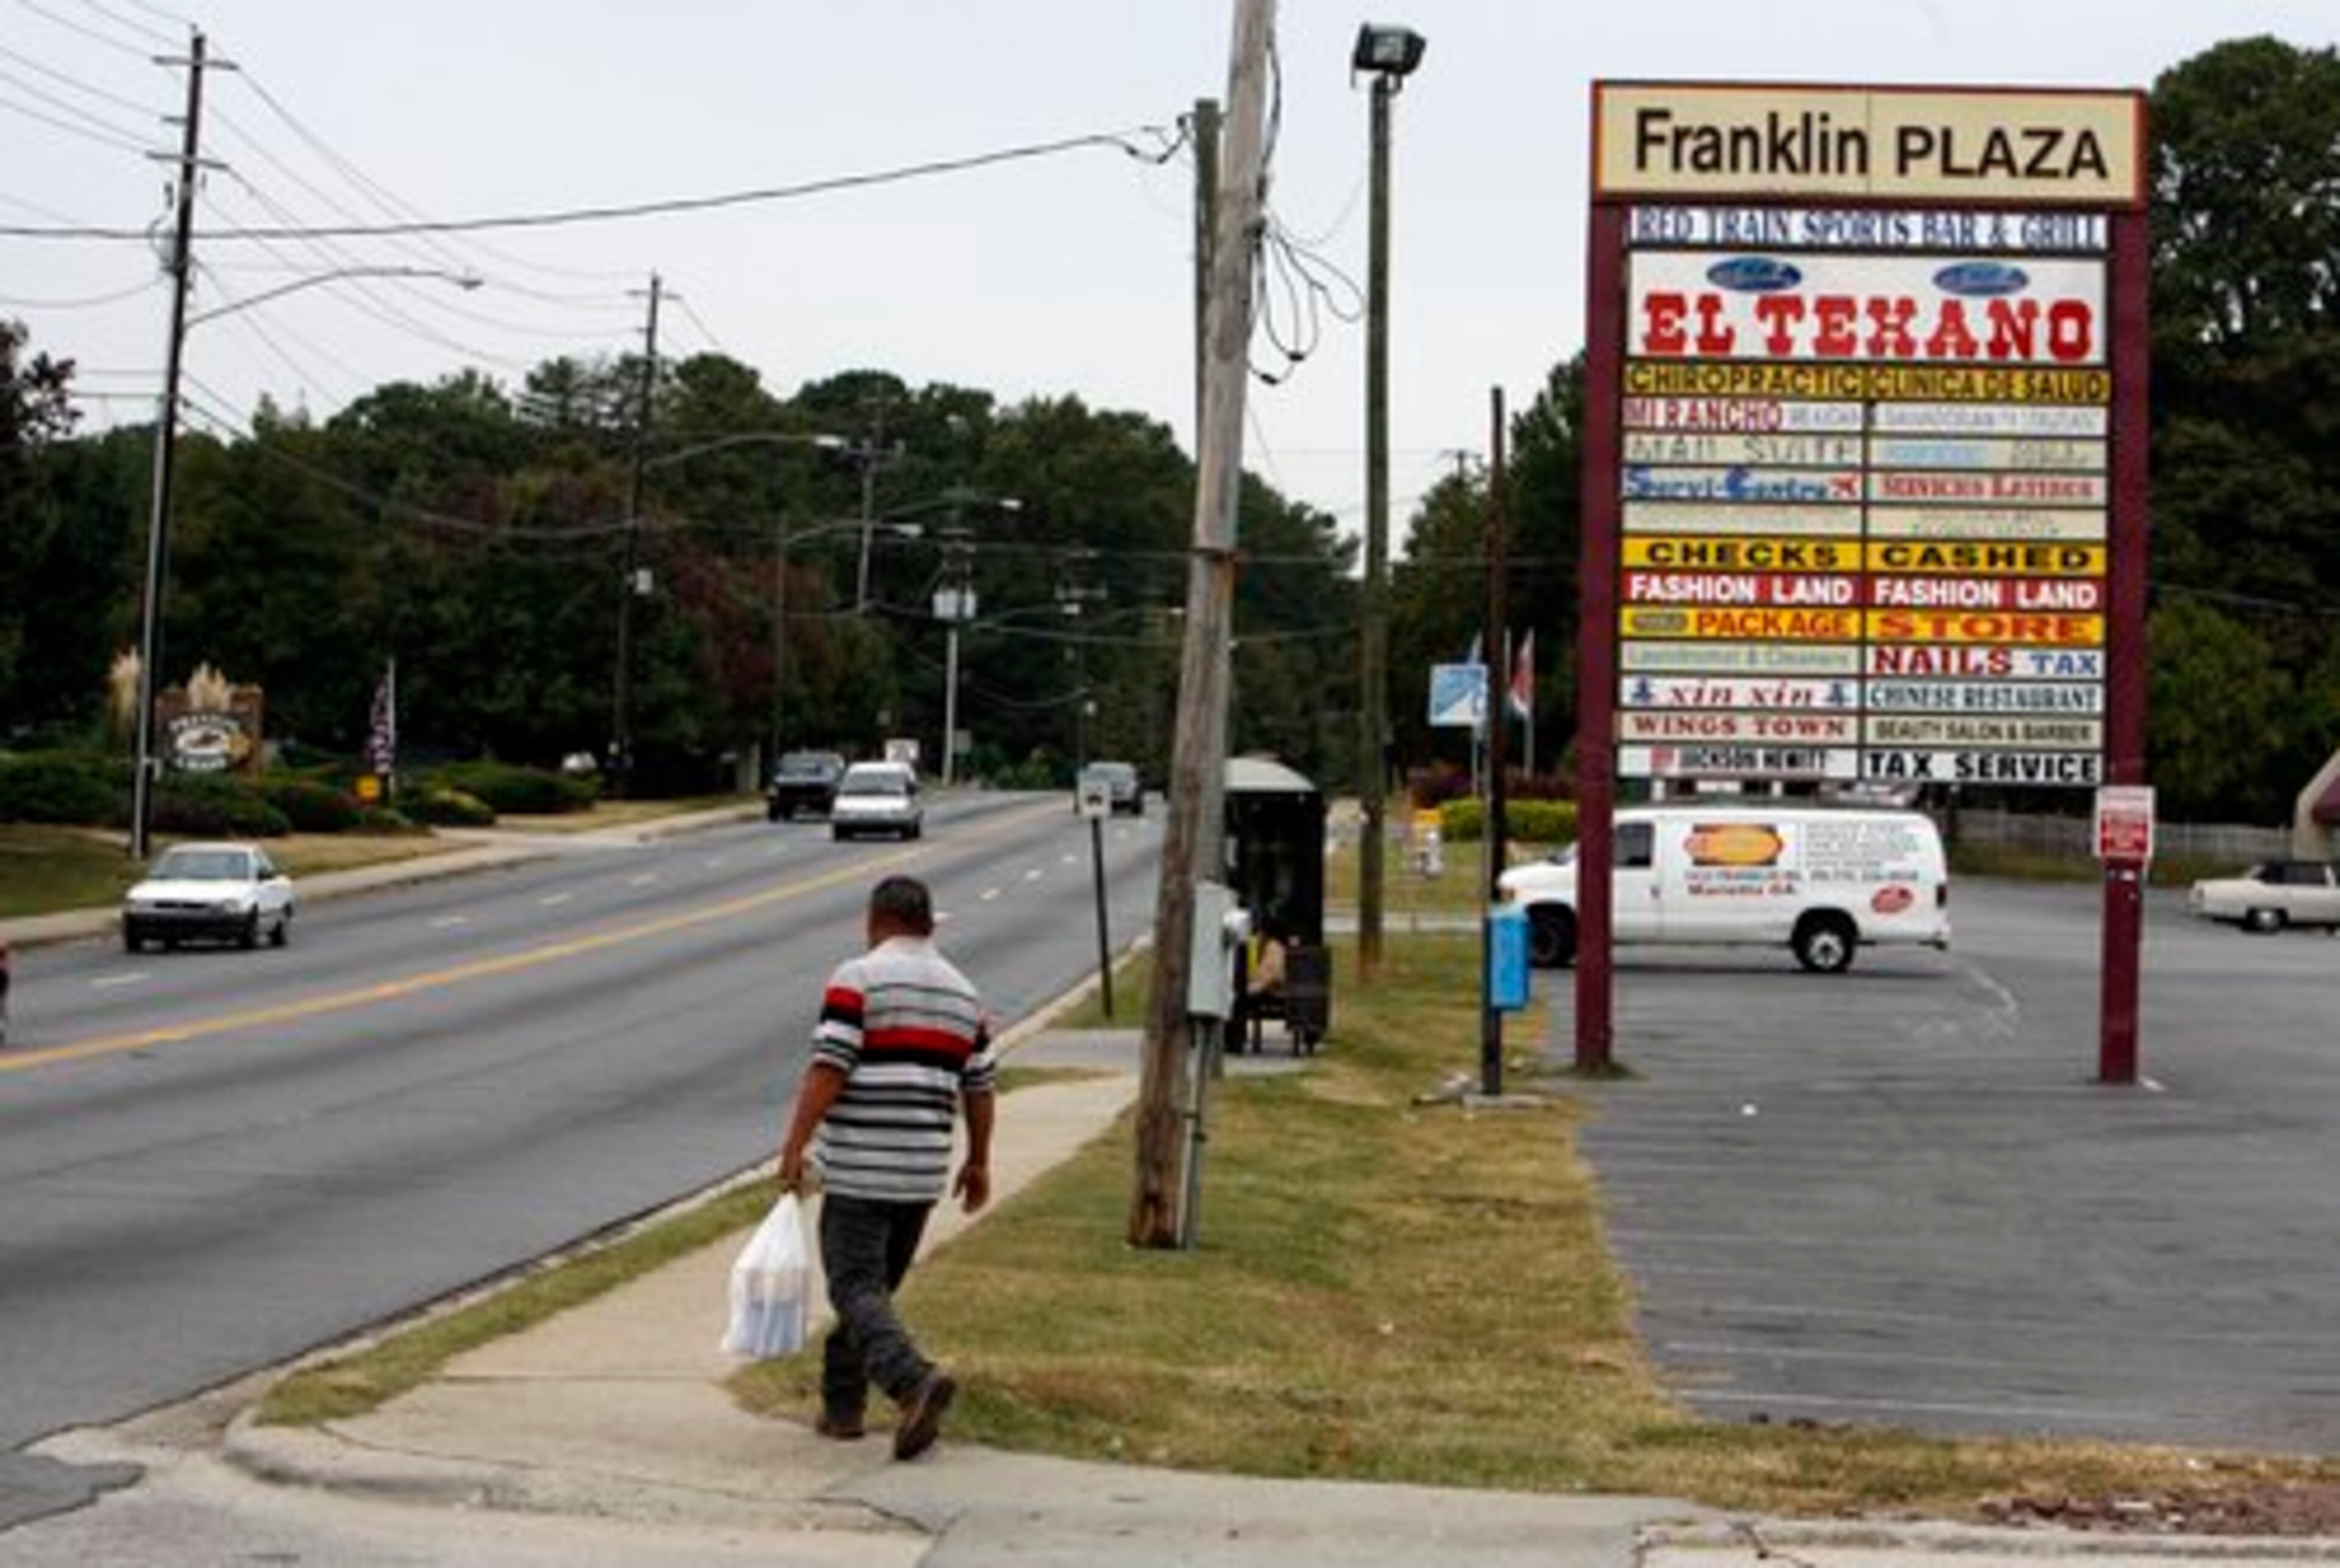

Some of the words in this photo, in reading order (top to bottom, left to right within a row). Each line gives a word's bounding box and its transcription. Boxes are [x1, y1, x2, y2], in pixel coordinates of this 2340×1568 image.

[1634, 108, 1869, 174] Franklin
[1895, 126, 2108, 179] PLAZA
[1638, 209, 1694, 241] RED
[1706, 209, 1792, 244] TRAIN
[1803, 210, 1910, 246] SPORTS
[1922, 213, 1976, 248] BAR
[2021, 215, 2096, 250] GRILL
[1643, 293, 1735, 353] EL
[1754, 295, 2093, 361] TEXANO
[1629, 366, 1860, 395] CHIROPRACTIC
[2022, 371, 2103, 400] SALUD
[1665, 397, 1784, 431] RANCHO
[1647, 542, 1839, 567] CHECKS
[1881, 545, 2093, 568] CASHED
[1629, 575, 1756, 602] FASHION
[1771, 576, 1854, 604] LAND
[1873, 579, 2001, 606] FASHION
[2015, 581, 2098, 609] LAND
[1696, 611, 1851, 637] PACKAGE
[1877, 614, 2093, 641] STORE
[1874, 648, 2012, 675] NAILS
[2029, 653, 2097, 675] TAX
[1870, 684, 1956, 708] CHINESE
[1963, 686, 2097, 712] RESTAURANT
[1633, 715, 1737, 736] WINGS
[1753, 718, 1846, 737] TOWN
[1868, 752, 1934, 778] TAX
[1954, 753, 2097, 780] SERVICE
